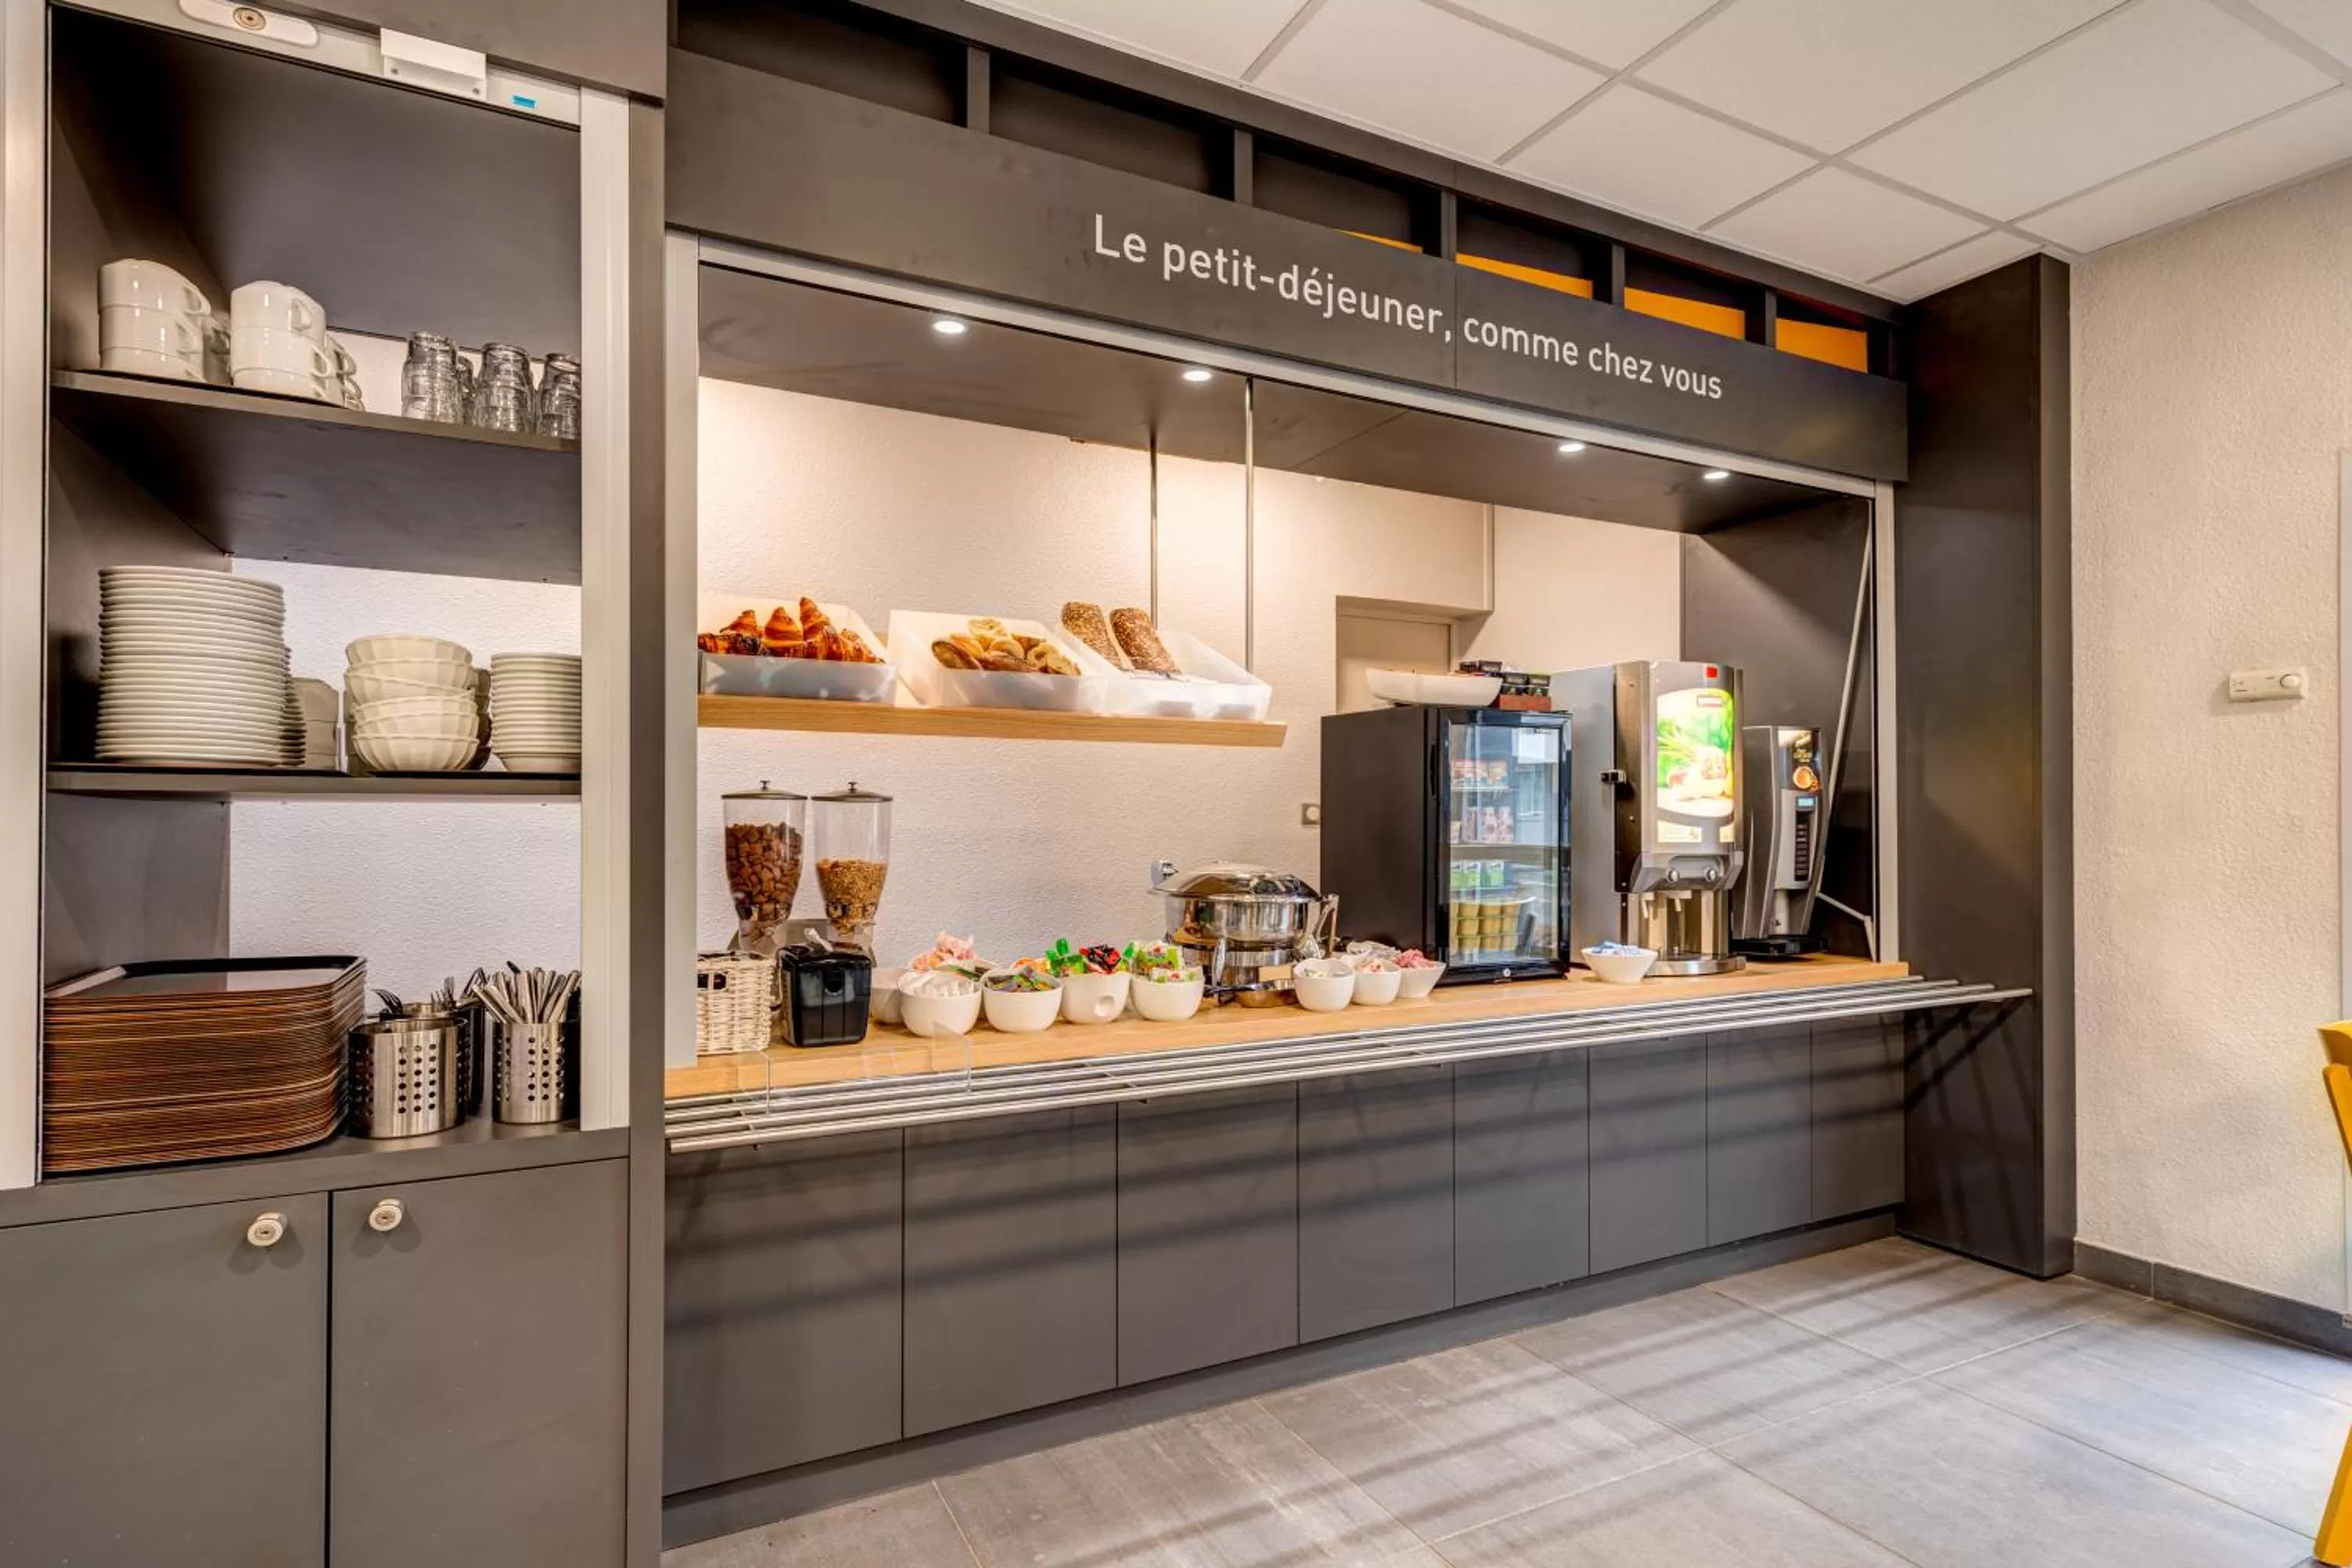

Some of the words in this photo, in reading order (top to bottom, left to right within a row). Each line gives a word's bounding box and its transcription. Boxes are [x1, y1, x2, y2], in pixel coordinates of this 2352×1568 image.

[1094, 213, 1147, 263] Le
[1163, 242, 1452, 344] petit-déjeuner,
[1463, 318, 1579, 366] comme
[1588, 342, 1653, 383] chez
[1660, 364, 1723, 399] vous
